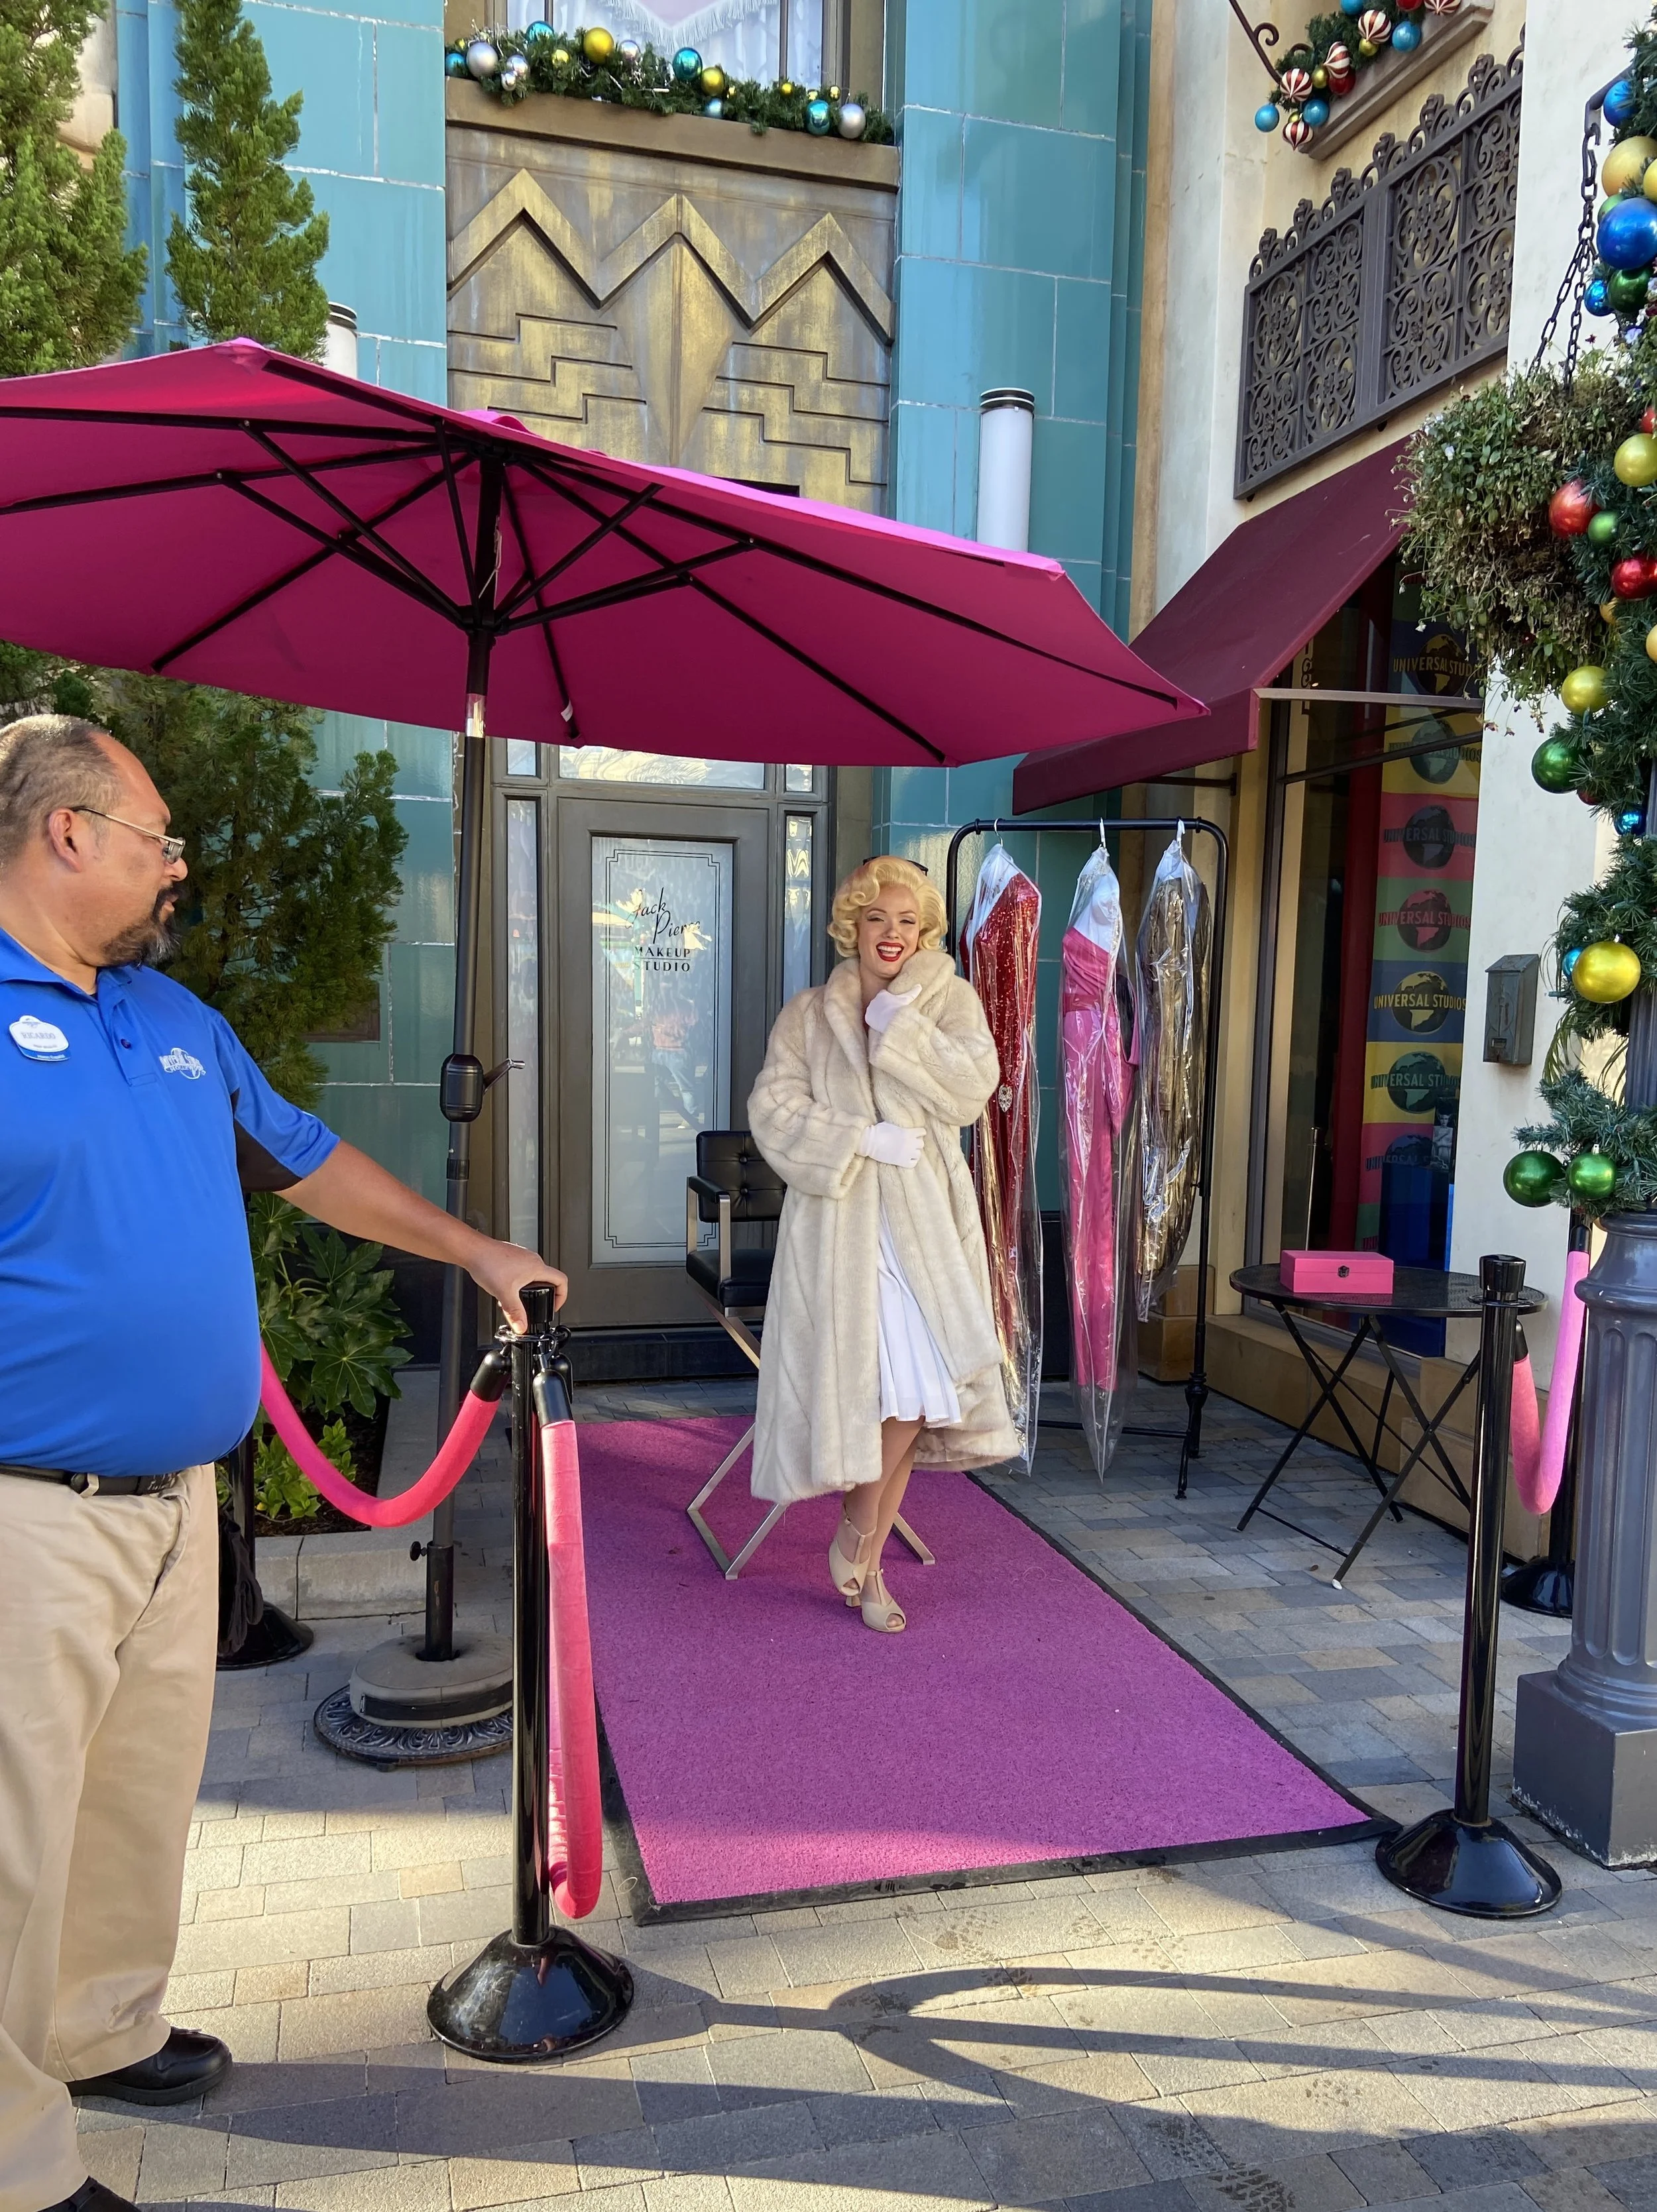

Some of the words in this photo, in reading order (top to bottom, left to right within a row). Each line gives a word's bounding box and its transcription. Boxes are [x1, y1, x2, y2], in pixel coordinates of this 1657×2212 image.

[1393, 657, 1448, 672] UNIVERSAL
[1449, 660, 1485, 679] STUDO
[1384, 828, 1440, 843] UNIVERSAL
[625, 887, 666, 928] Jack
[1378, 911, 1435, 926] UNIVERSAL
[1438, 911, 1471, 930] STUDIOS
[635, 946, 691, 958] MAKEUP
[634, 960, 690, 972] STUDIO
[1374, 994, 1430, 1009] UNIVERSAL
[1433, 994, 1466, 1011] STUDIOS
[1371, 1074, 1424, 1089] UNIVERSAL
